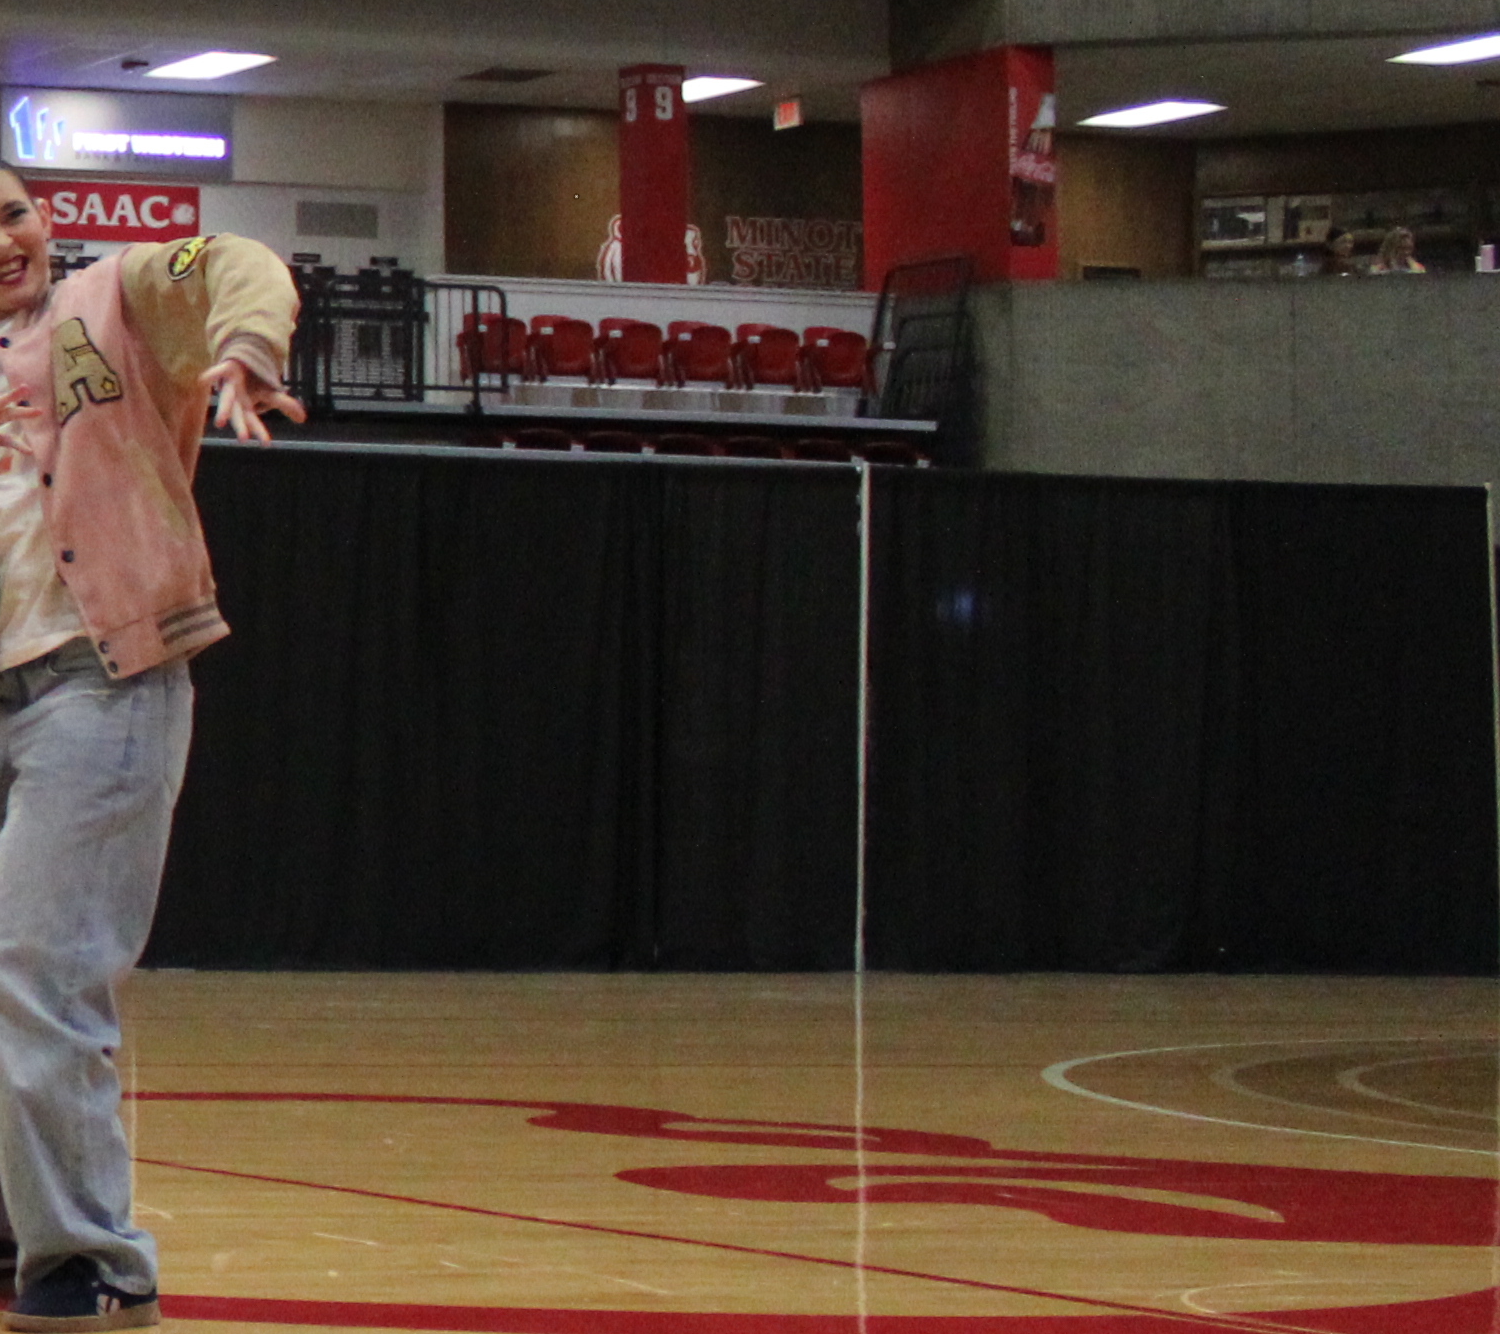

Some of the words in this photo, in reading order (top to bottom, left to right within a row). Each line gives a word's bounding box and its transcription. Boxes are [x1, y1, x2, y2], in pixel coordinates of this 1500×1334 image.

[654, 85, 674, 121] 9
[51, 192, 171, 229] SAAC
[725, 215, 864, 249] MINOT
[731, 249, 862, 285] STATE
